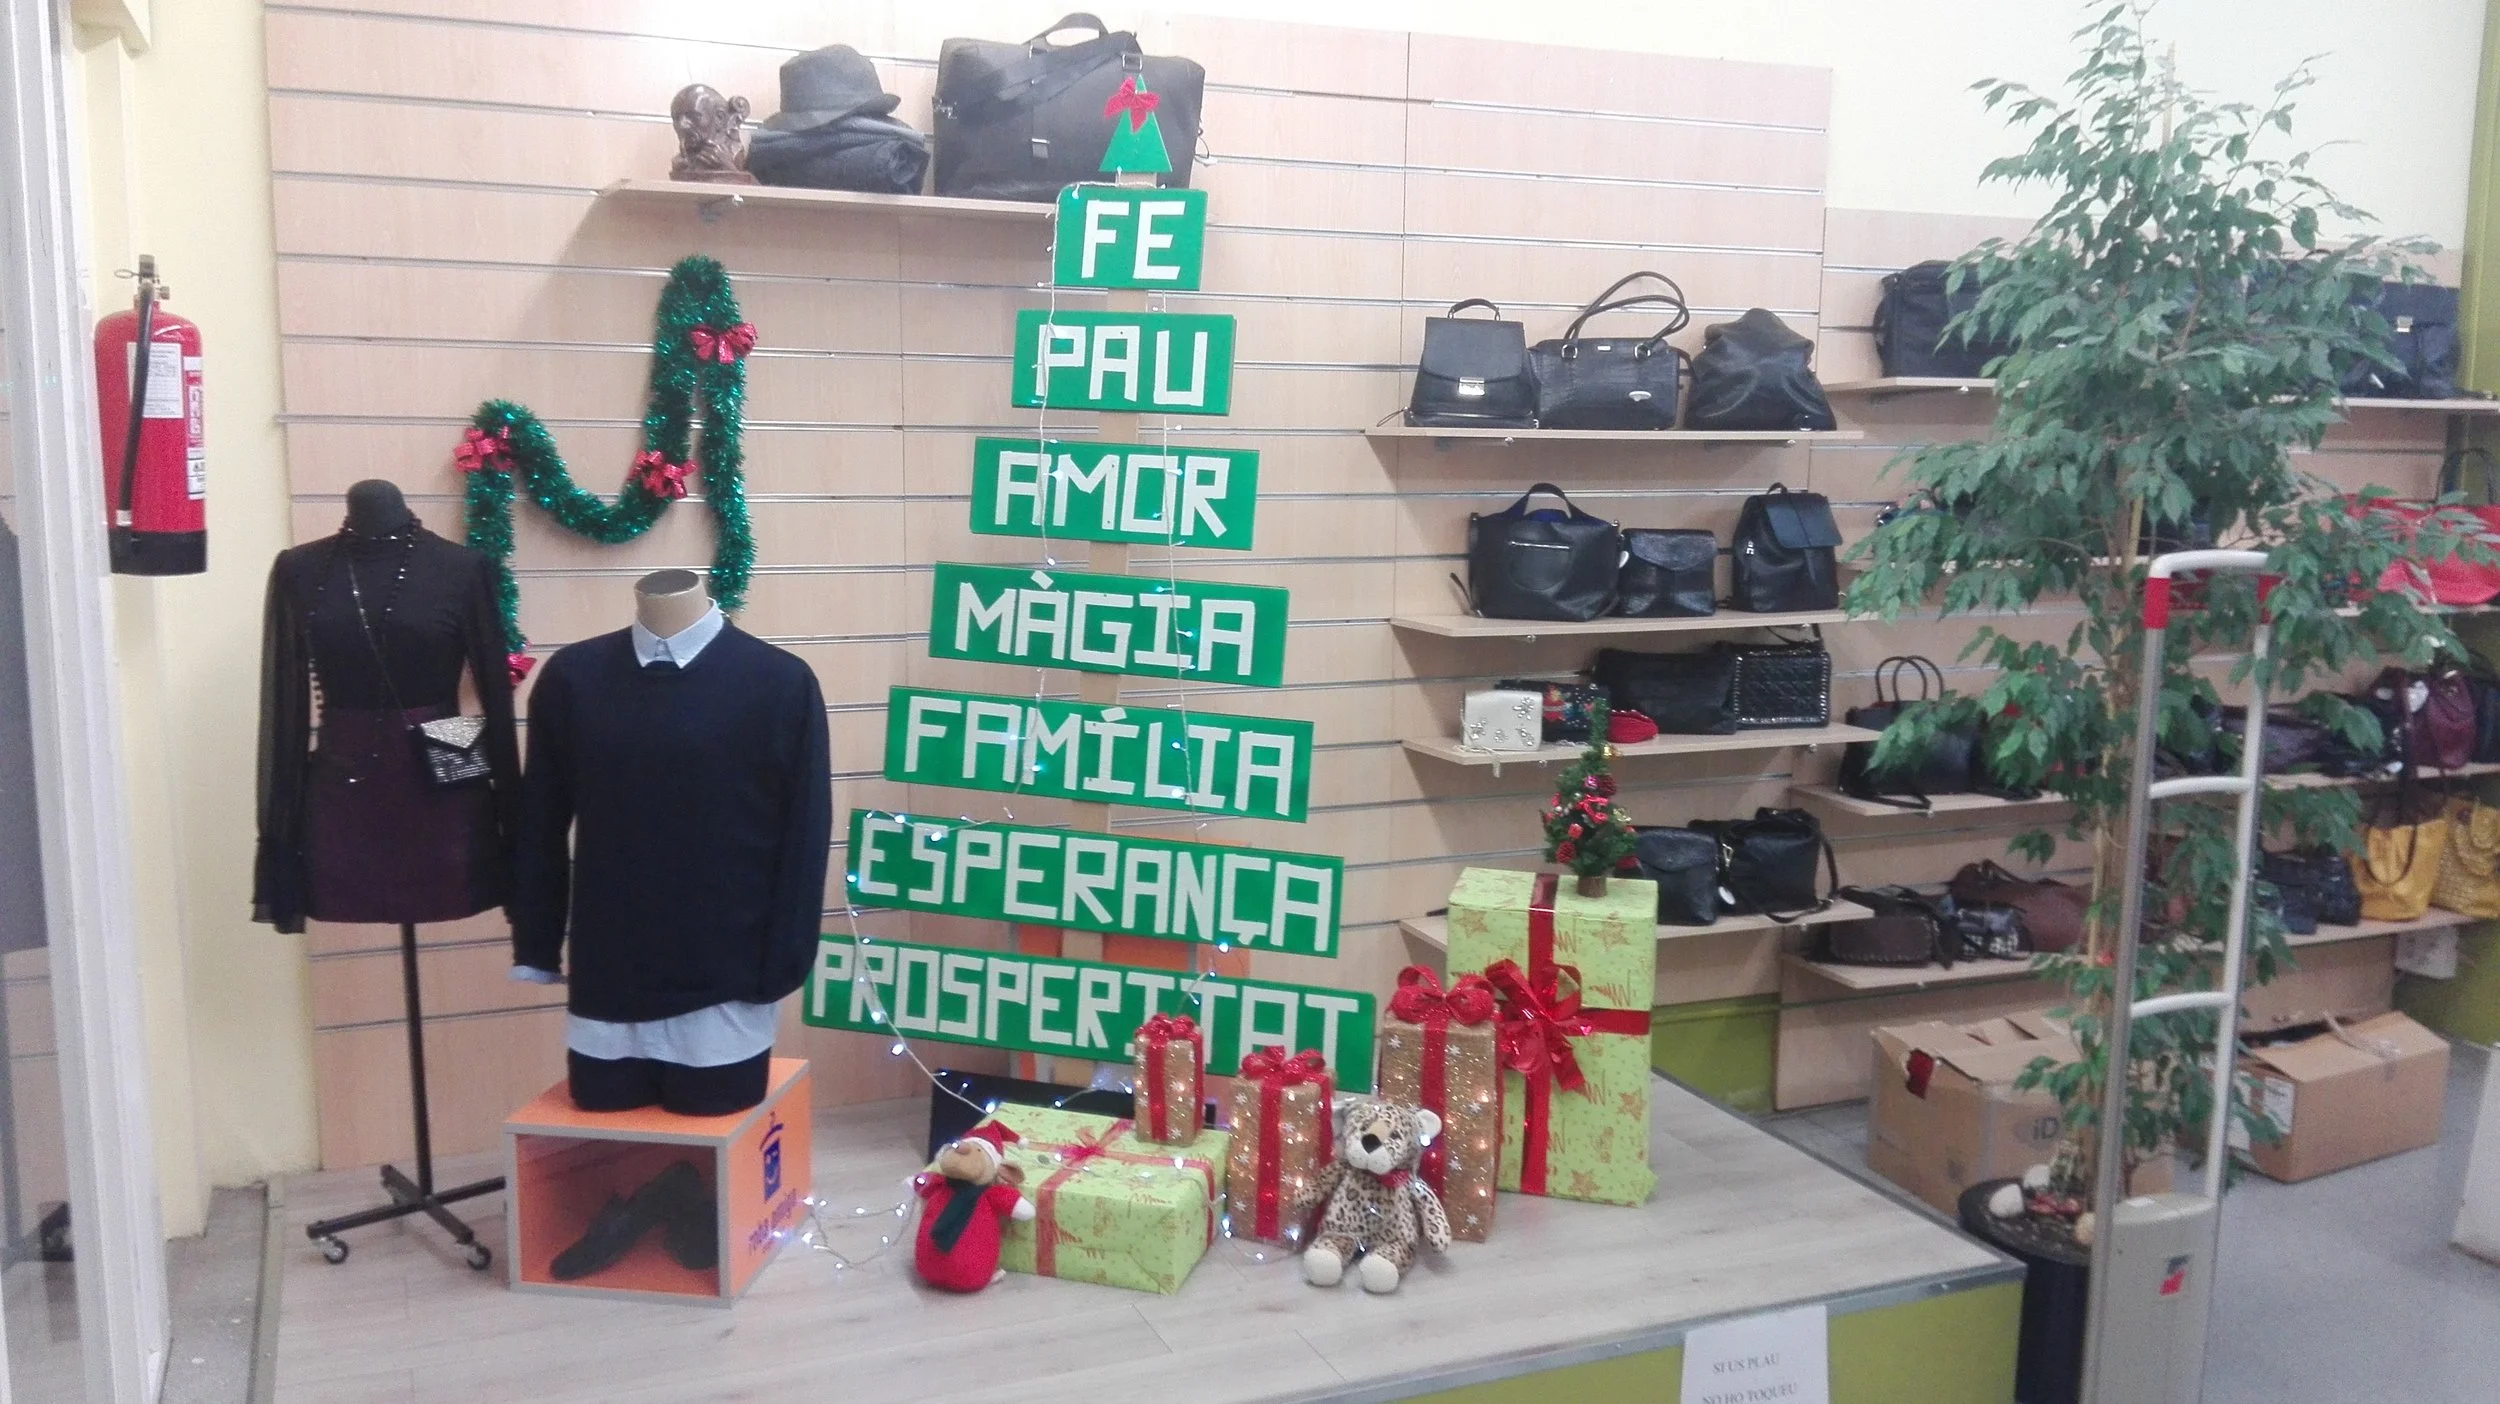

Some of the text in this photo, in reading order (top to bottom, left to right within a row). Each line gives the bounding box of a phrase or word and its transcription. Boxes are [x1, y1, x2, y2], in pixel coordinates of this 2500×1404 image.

[1081, 200, 1186, 280] FE
[1035, 324, 1209, 407] PAU
[994, 450, 1231, 538] AMOR
[954, 570, 1255, 676] MÀGIA
[904, 695, 1295, 817] FAMÍLIA
[857, 817, 1333, 952] ESPERANÇA
